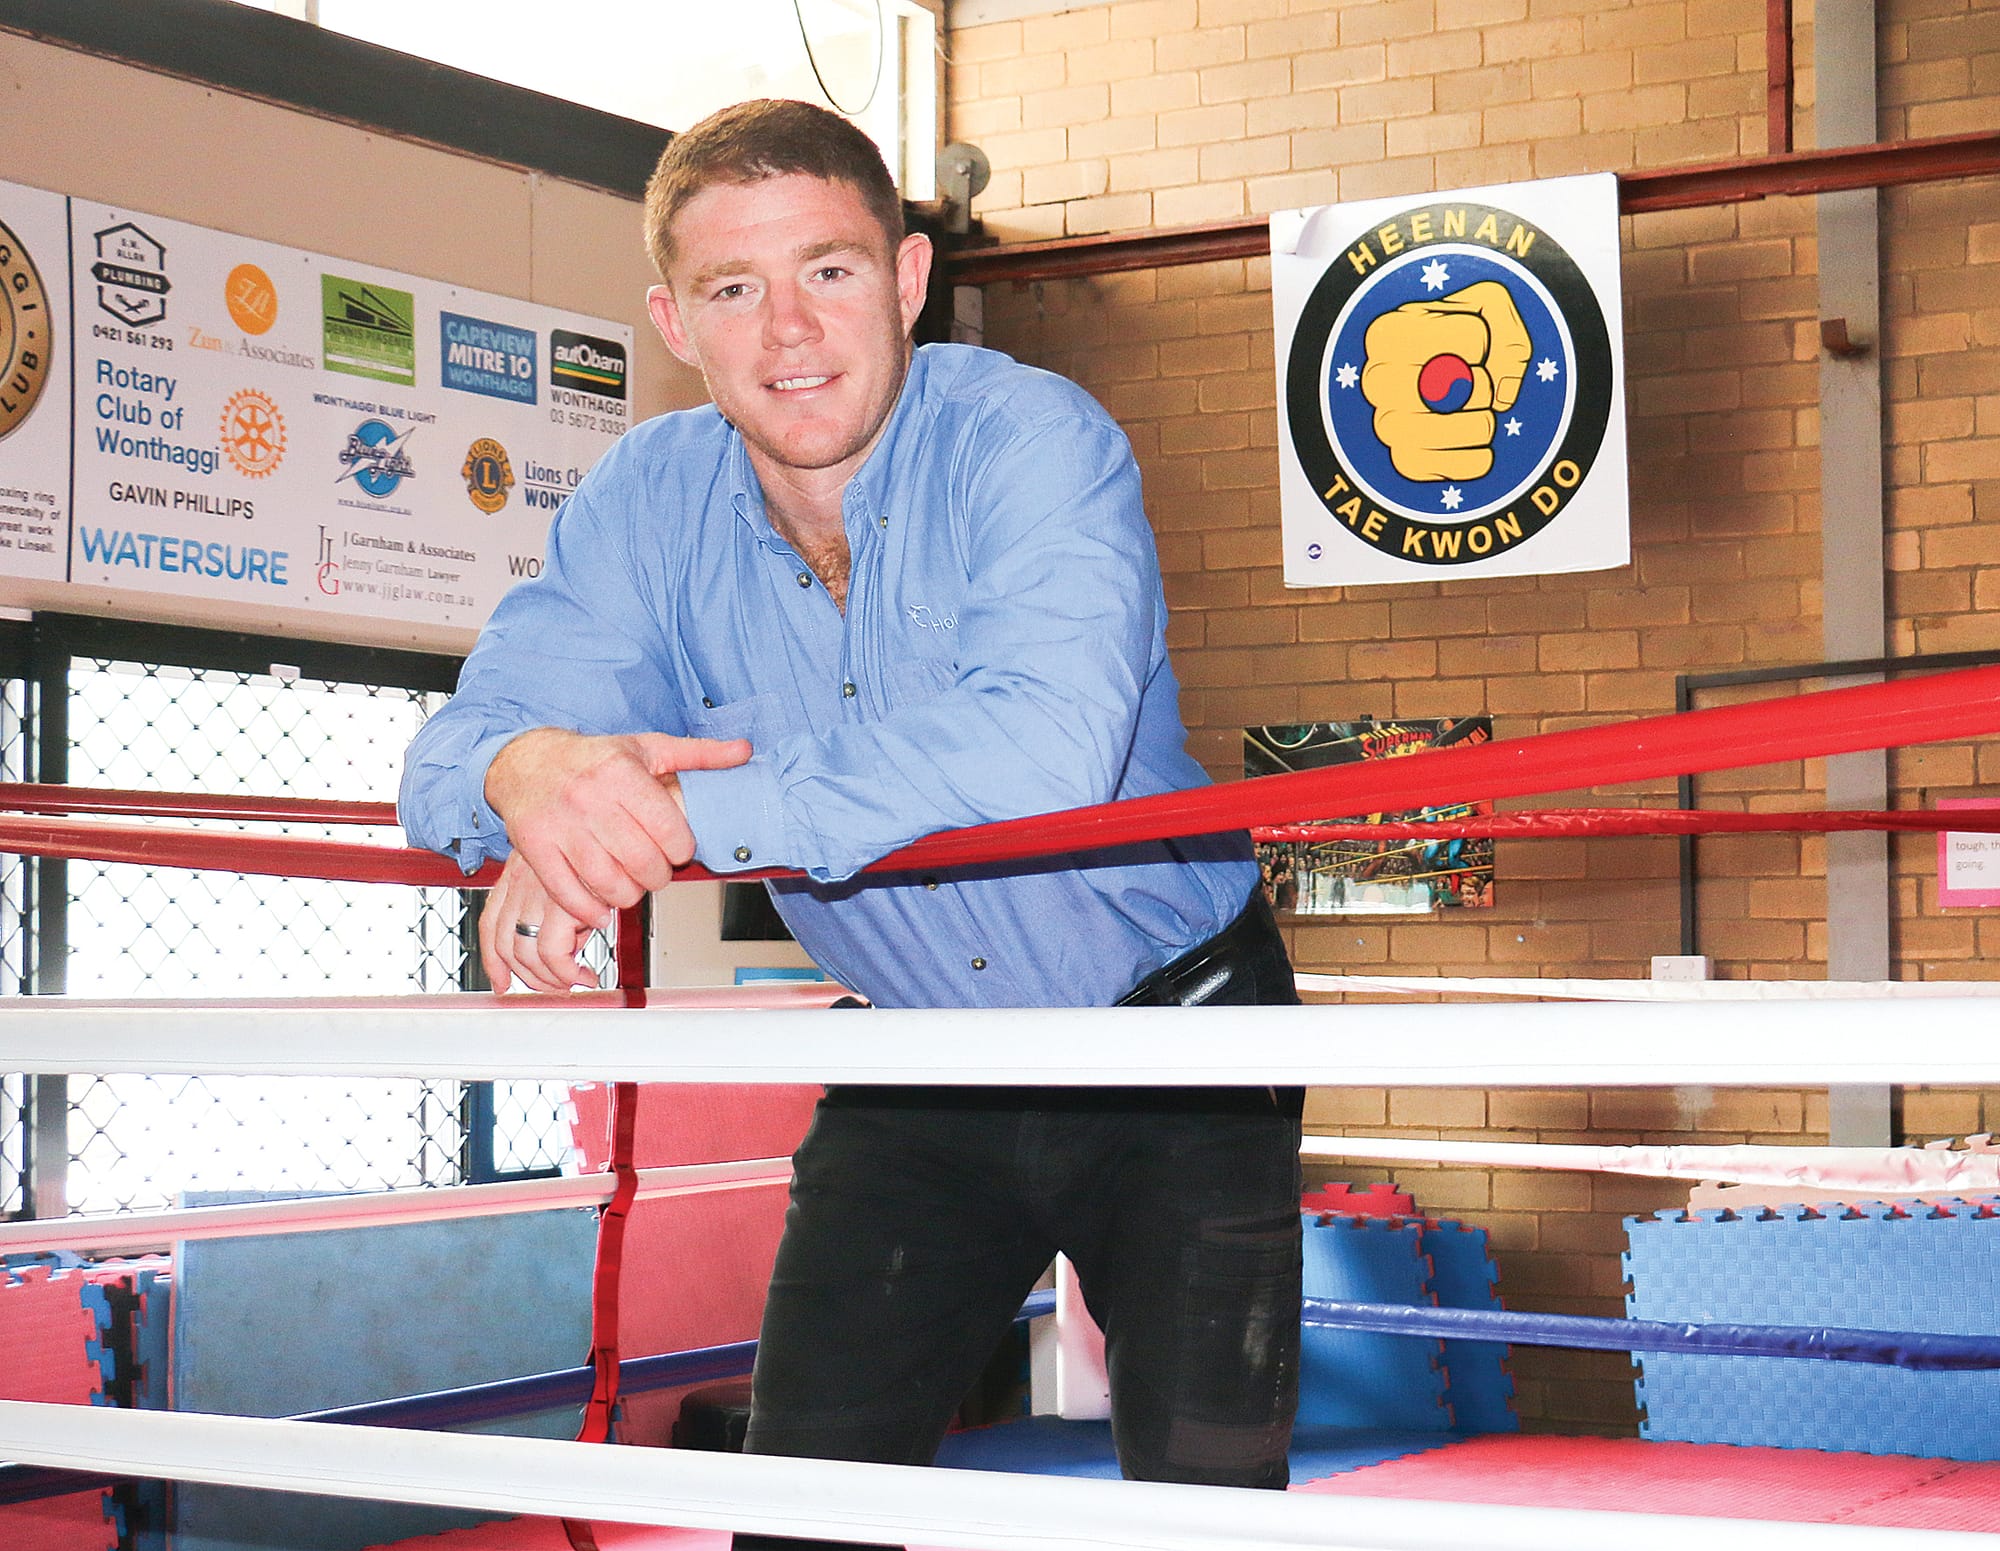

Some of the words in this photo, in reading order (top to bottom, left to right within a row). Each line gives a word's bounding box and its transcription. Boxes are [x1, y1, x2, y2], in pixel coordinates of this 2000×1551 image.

[1347, 209, 1536, 276] HEENAN
[102, 267, 162, 290] PLUMBING
[93, 324, 122, 342] 0421
[127, 331, 147, 347] 561
[151, 336, 174, 352] 293
[446, 321, 532, 357] CAPEVIEW
[241, 338, 316, 370] Associates
[448, 342, 505, 374] MITRE
[509, 354, 532, 379] 10
[97, 359, 177, 400] Rotary
[448, 366, 533, 398] WONTHAGGI
[96, 394, 151, 425] Club
[161, 408, 184, 431] of
[313, 393, 376, 413] WONTHAGGI
[379, 405, 405, 419] BLUE
[408, 411, 436, 424] LIGHT
[551, 389, 627, 417] WONTHAGGI
[551, 408, 564, 424] 03
[568, 412, 597, 435] 5672
[600, 418, 627, 436] 3333
[96, 427, 220, 475] Wonthaggi
[482, 461, 497, 489] L
[525, 461, 561, 485] Lions
[33, 492, 56, 506] ring
[109, 482, 168, 508] GAVIN
[173, 491, 255, 520] PHILLIPS
[1323, 474, 1388, 542] TAE
[1401, 513, 1523, 559] KWON
[1531, 458, 1582, 518] DO
[50, 510, 61, 520] of
[28, 525, 54, 536] work
[80, 526, 289, 586] WATERSURE
[351, 533, 404, 553] Garnham
[407, 541, 416, 554] &
[419, 543, 476, 563] Associates
[342, 555, 374, 575] Jenny
[376, 560, 424, 578] Garnham
[428, 568, 461, 583] Lawyer
[342, 580, 475, 607] www.jjglaw.com.au
[1361, 731, 1433, 761] SUPERMAN
